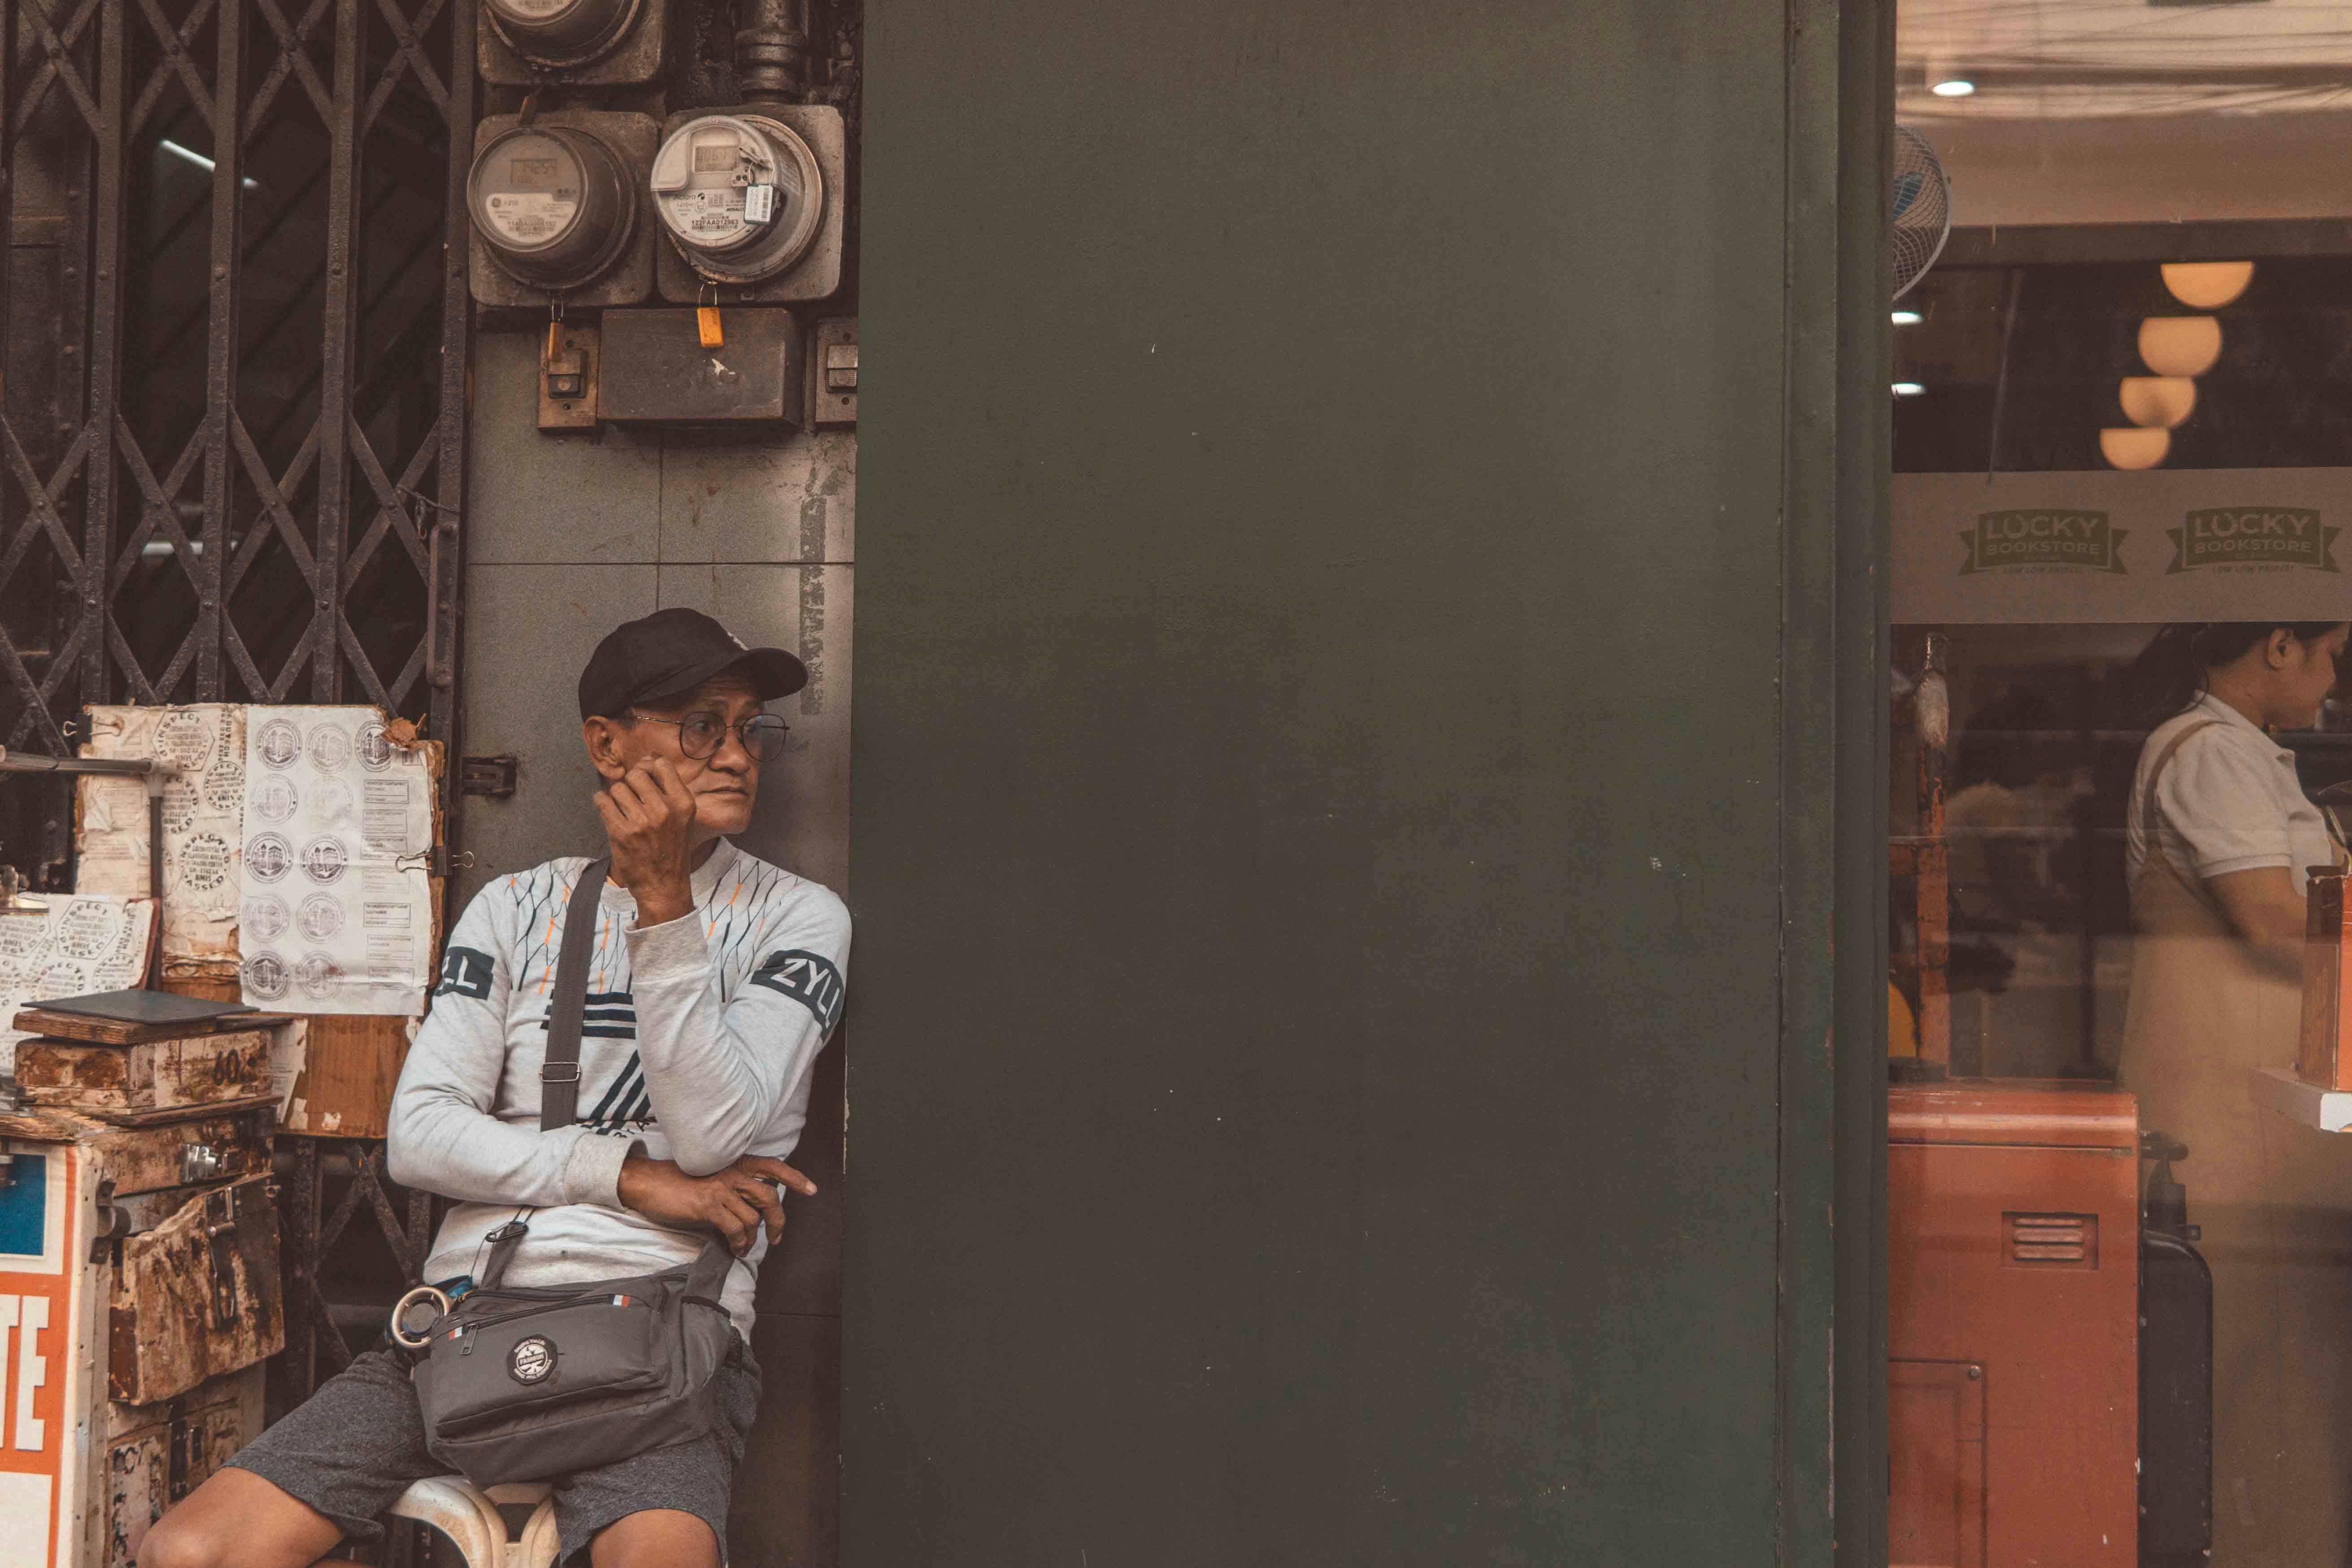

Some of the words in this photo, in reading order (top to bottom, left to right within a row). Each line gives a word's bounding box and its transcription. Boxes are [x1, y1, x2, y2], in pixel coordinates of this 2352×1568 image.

[1986, 541, 2100, 556] BOOKSTORE
[2195, 539, 2312, 554] BOOKSTORE
[770, 958, 840, 1029] ZYLL
[519, 1353, 544, 1366] FASHION
